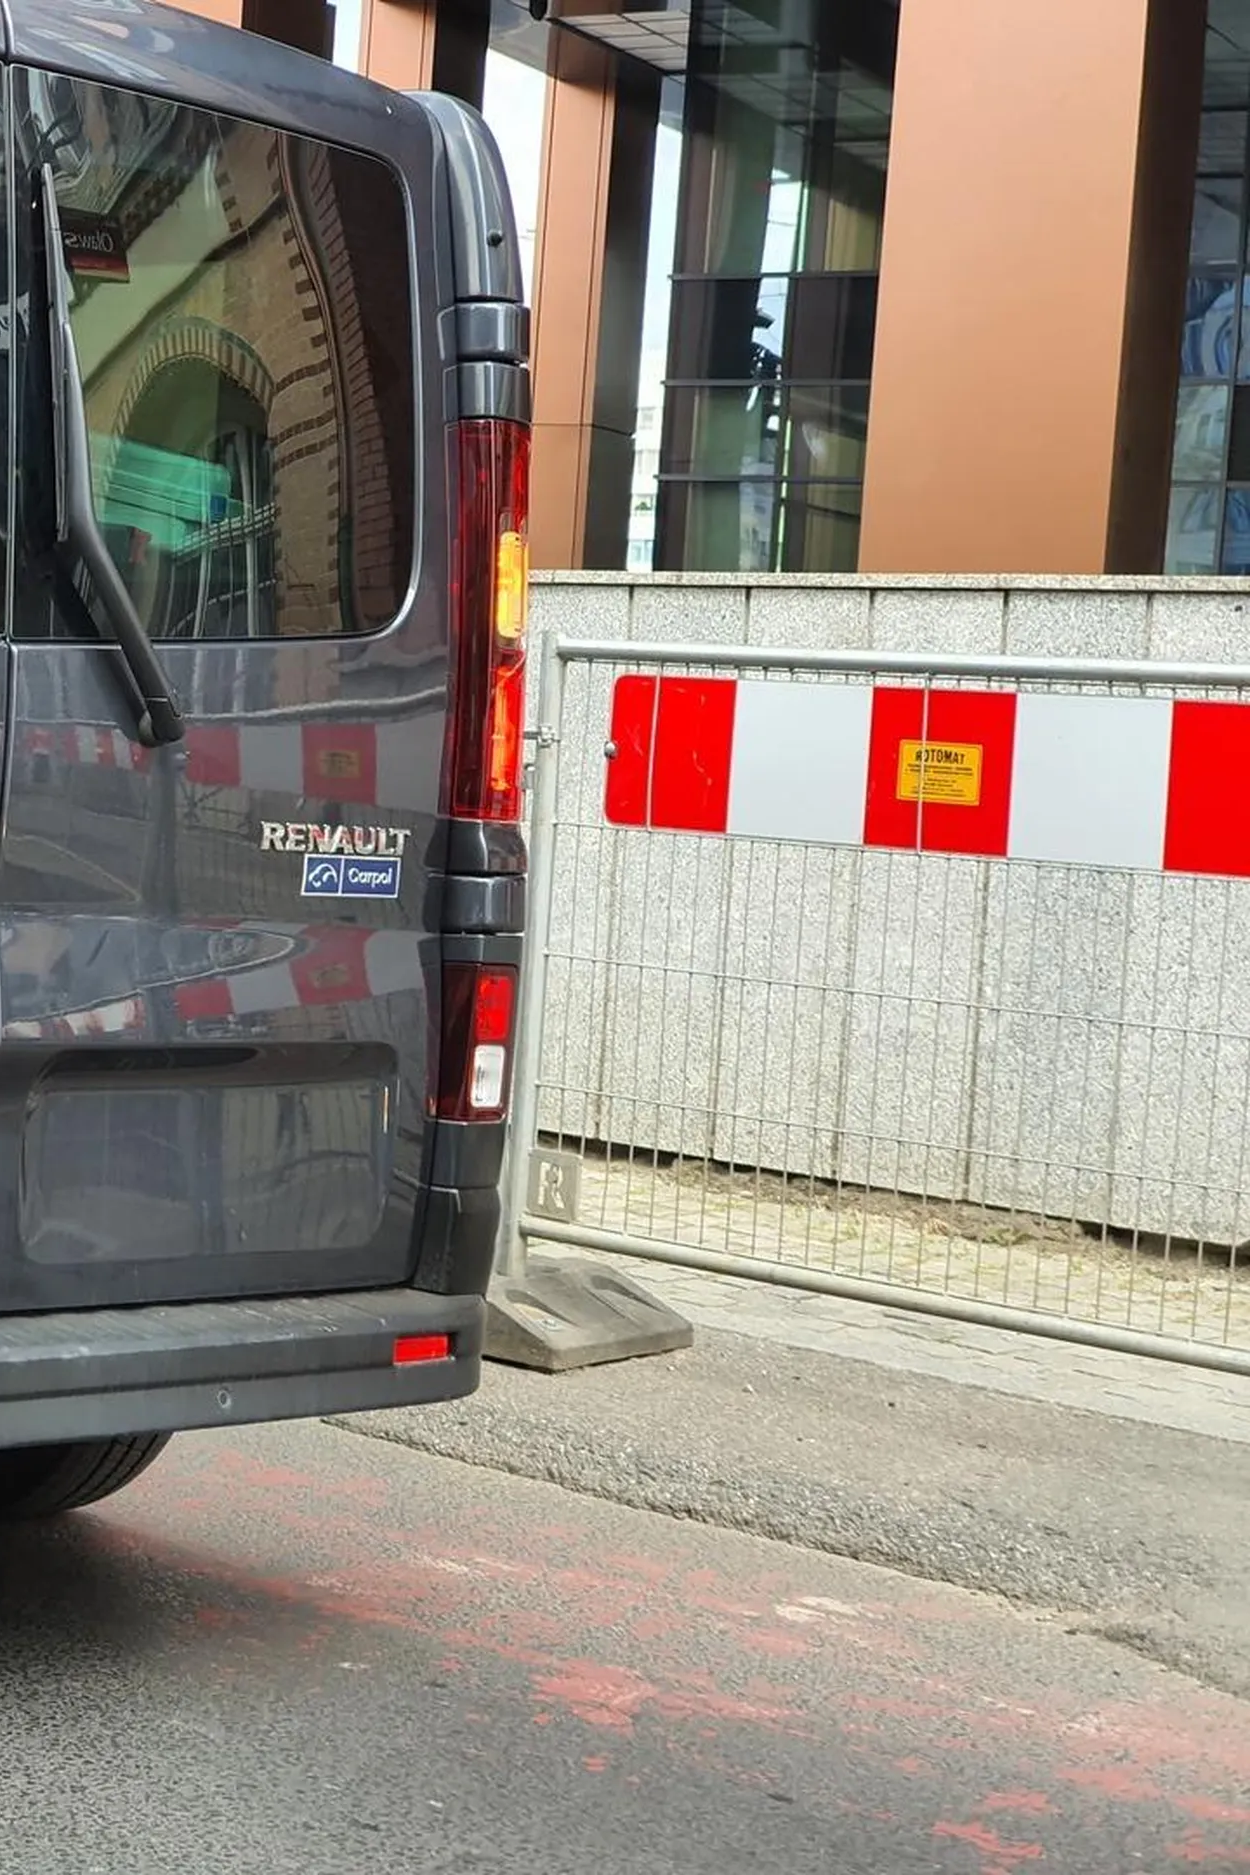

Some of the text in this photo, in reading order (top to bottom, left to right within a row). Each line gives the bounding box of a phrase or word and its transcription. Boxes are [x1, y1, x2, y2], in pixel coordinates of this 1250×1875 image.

[915, 748, 966, 764] ROTOMAT
[260, 820, 411, 856] RENAULT
[349, 867, 393, 888] Carpol
